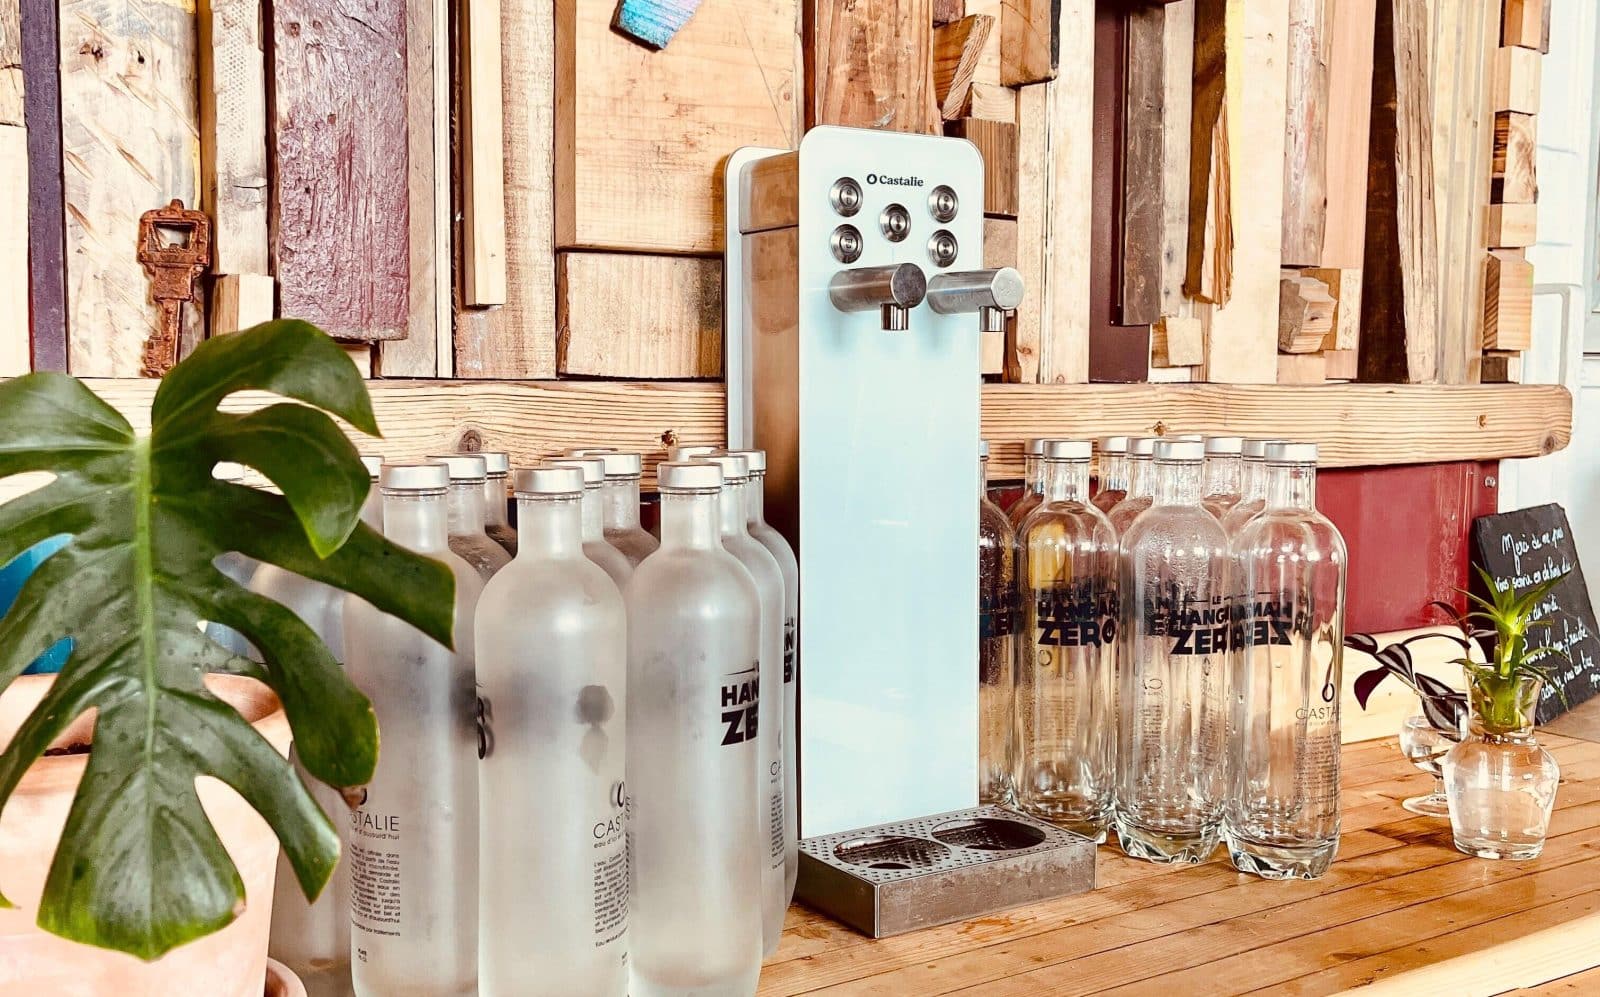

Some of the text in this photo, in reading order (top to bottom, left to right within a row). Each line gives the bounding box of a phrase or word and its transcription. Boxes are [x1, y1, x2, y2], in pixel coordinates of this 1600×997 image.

[879, 175, 924, 187] Castalie
[1532, 533, 1542, 550] de
[1212, 596, 1222, 605] LE
[1038, 619, 1115, 648] ZERO
[721, 679, 759, 707] HAN
[720, 702, 759, 746] ZE
